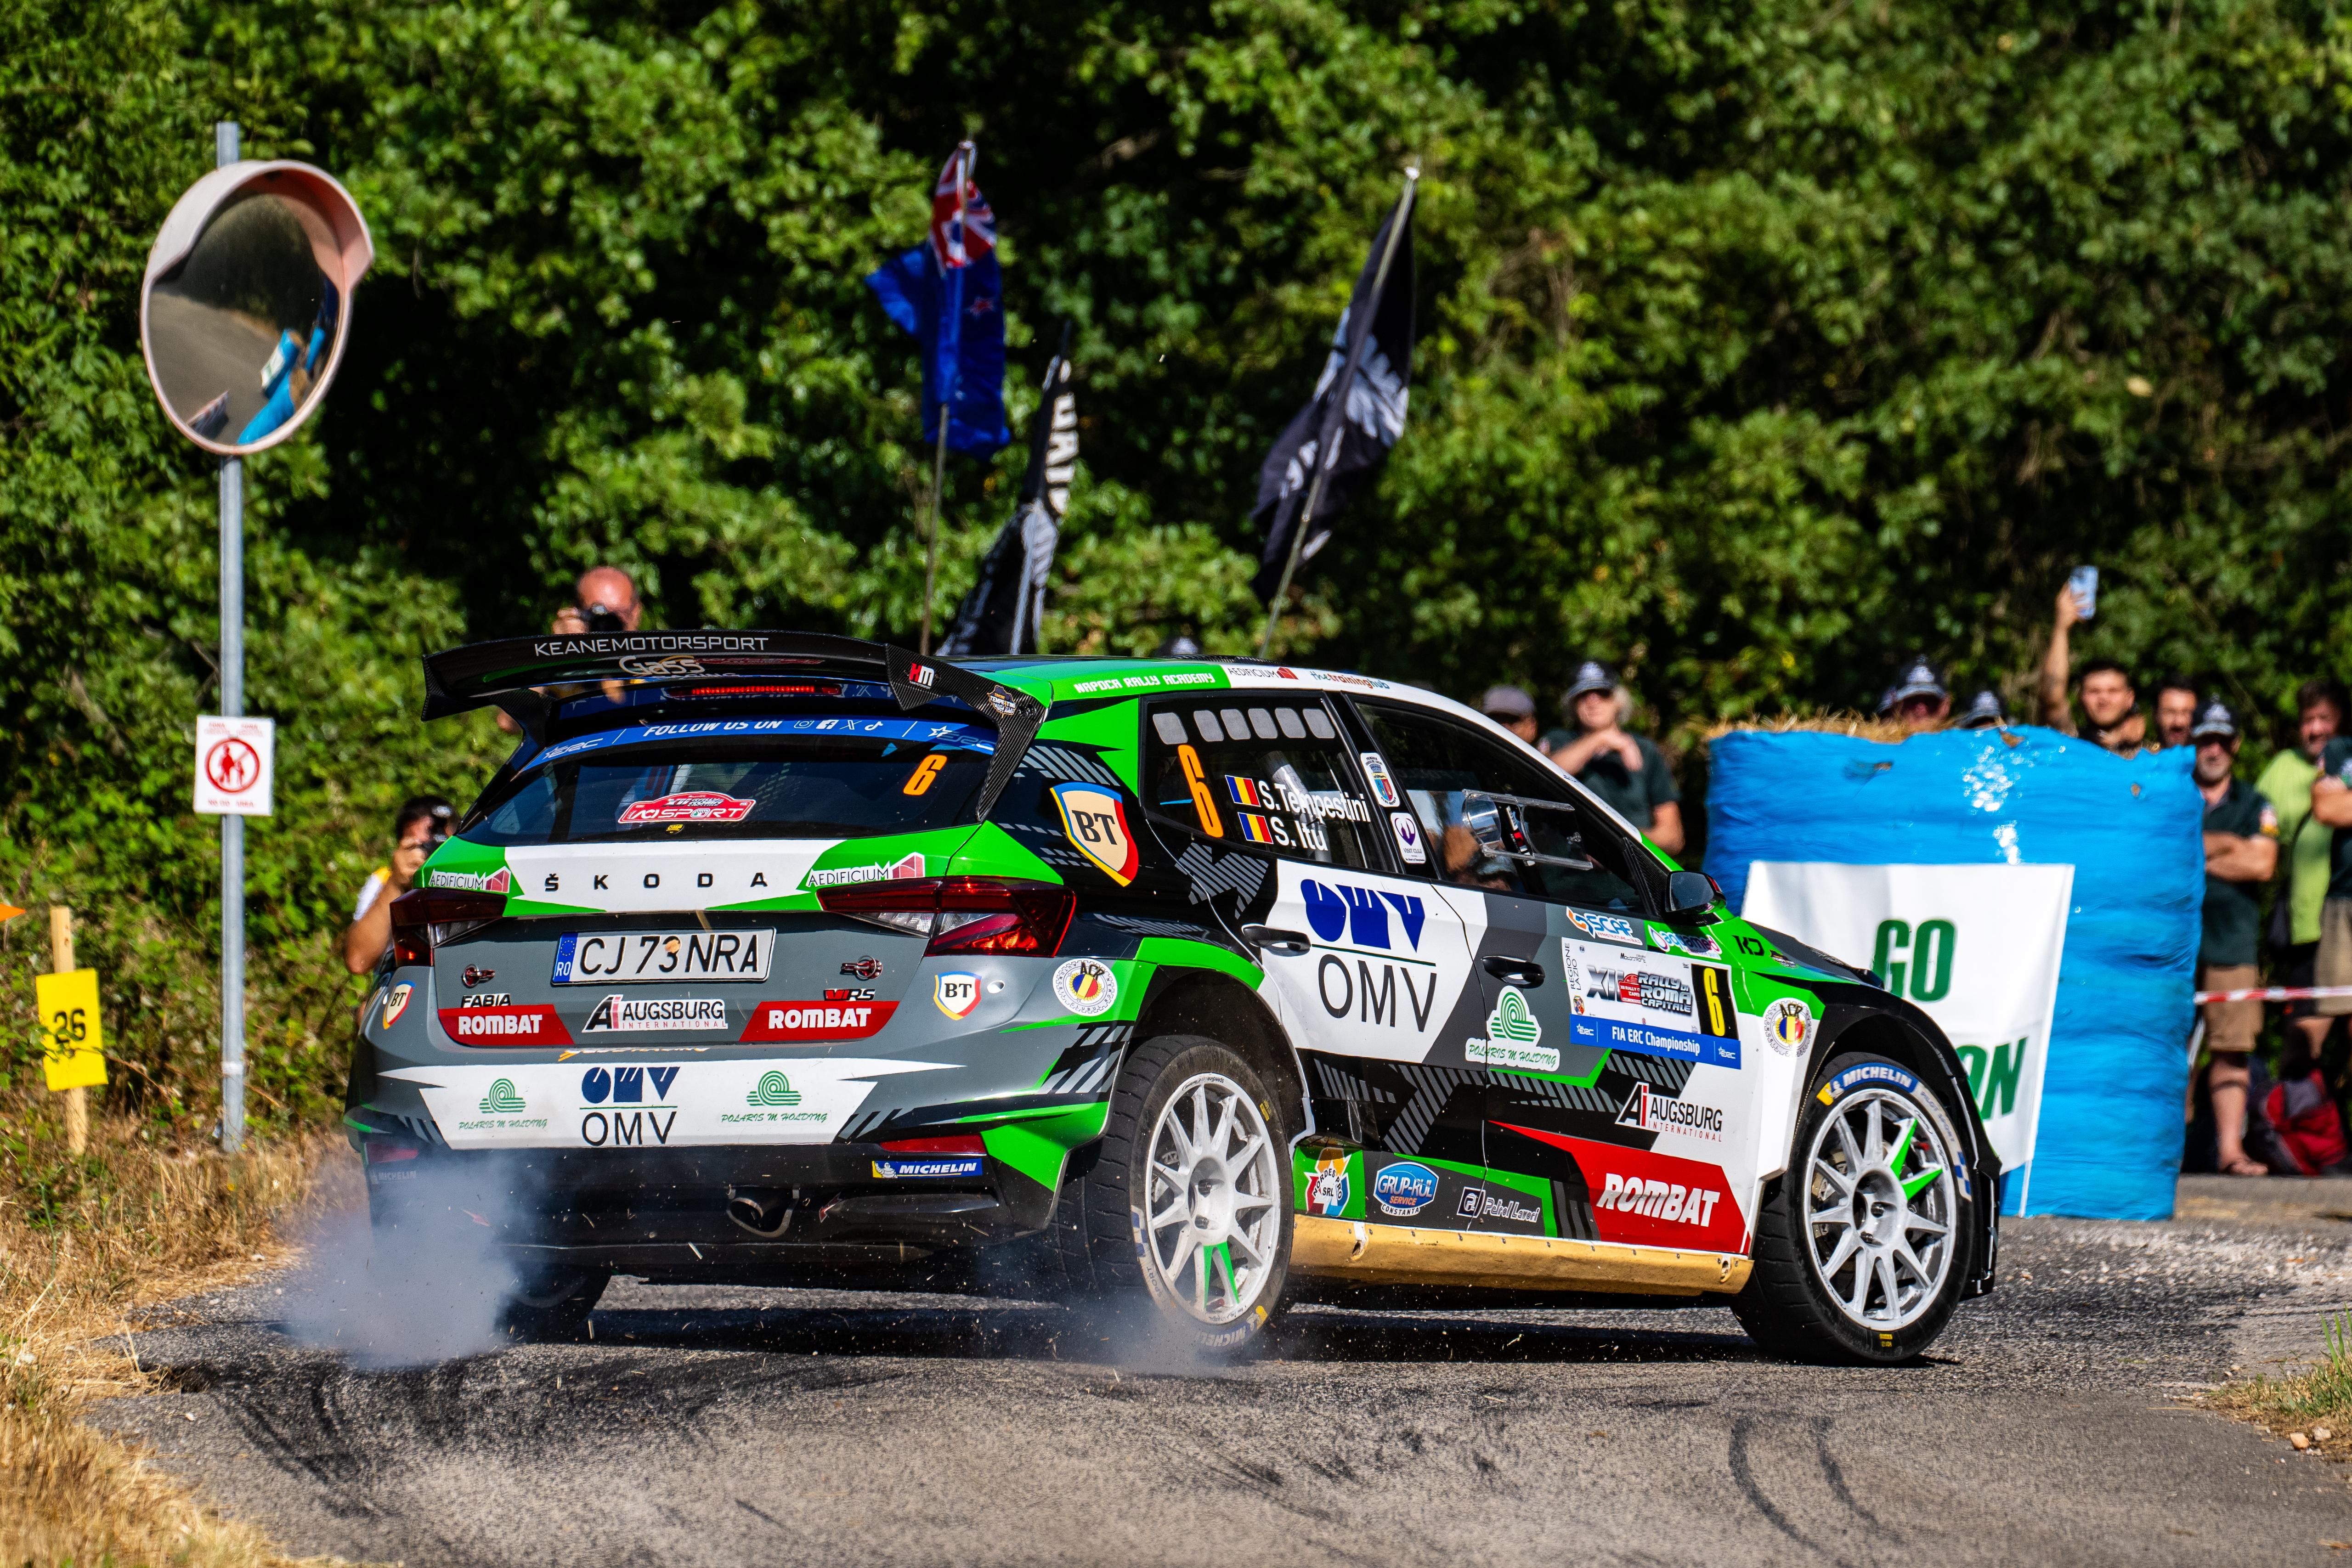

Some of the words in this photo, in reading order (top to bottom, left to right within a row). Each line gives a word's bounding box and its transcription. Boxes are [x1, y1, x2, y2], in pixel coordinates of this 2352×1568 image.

[534, 637, 769, 656] KEANEMOTORSPORT
[1074, 679, 1122, 693] NAPOCA
[1124, 675, 1160, 688] RALLY
[1163, 672, 1216, 684] ACADEMY
[1228, 666, 1278, 679] AEDIFICIUM
[643, 722, 723, 737] FOLLOW
[724, 721, 752, 730] US
[754, 721, 782, 730] ON
[903, 754, 947, 795] 6
[1178, 745, 1223, 838] 6
[1072, 809, 1117, 846] BT
[1270, 816, 1297, 847] S.
[1294, 820, 1329, 851] Itu
[430, 873, 485, 890] AEDIFICIUM
[545, 872, 768, 892] ŠKODA
[808, 866, 889, 887] AEDIFICIUM
[1662, 932, 1720, 952] aquamed
[581, 938, 624, 975] CJ
[640, 936, 681, 974] 73
[684, 933, 758, 973] NRA
[1872, 919, 1958, 1002] GO
[555, 961, 571, 976] RO
[1080, 962, 1105, 981] ACR
[1565, 942, 1576, 989] REGIONE
[1571, 959, 1582, 990] LAZIO
[944, 983, 972, 999] BT
[1638, 971, 1680, 989] RALLY
[1680, 982, 1689, 992] DI
[390, 992, 407, 1007] BT
[461, 993, 511, 1007] FABIA
[1318, 954, 1437, 1032] OMV
[1640, 985, 1692, 1005] ROMA
[1703, 967, 1725, 1037] 6
[622, 1001, 724, 1020] AUGSBURG
[1641, 998, 1692, 1013] CAPITALE
[1779, 1003, 1803, 1019] ACR
[54, 1007, 86, 1044] 26
[459, 1014, 542, 1035] ROMBAT
[622, 1020, 727, 1029] INTERNATIONAL
[768, 1008, 871, 1029] ROMBAT
[1611, 1027, 1626, 1041] FIA
[1628, 1029, 1644, 1044] ERC
[1645, 1032, 1700, 1056] Championship
[1469, 1044, 1505, 1059] POLARIS
[1508, 1049, 1518, 1060] M
[1519, 1050, 1556, 1066] HOLDING
[1842, 1066, 1912, 1089] MICHELIN
[1956, 1036, 2029, 1121] ON
[459, 1121, 495, 1130] POLARIS
[498, 1120, 506, 1128] M
[508, 1118, 548, 1129] HOLDING
[721, 1113, 765, 1123] POLARIS
[768, 1113, 779, 1122] M
[780, 1113, 828, 1123] HOLDING
[1650, 1097, 1722, 1132] AUGSBURG
[582, 1111, 677, 1146] OMV
[1648, 1121, 1722, 1143] INTERNATIONAL
[899, 1162, 977, 1174] MICHELIN
[1313, 1168, 1336, 1197] NORDES
[1322, 1187, 1334, 1196] SRL
[1389, 1196, 1417, 1206] SERVICE
[1597, 1172, 1720, 1228] ROMBAT
[1146, 1266, 1163, 1298] SPORT
